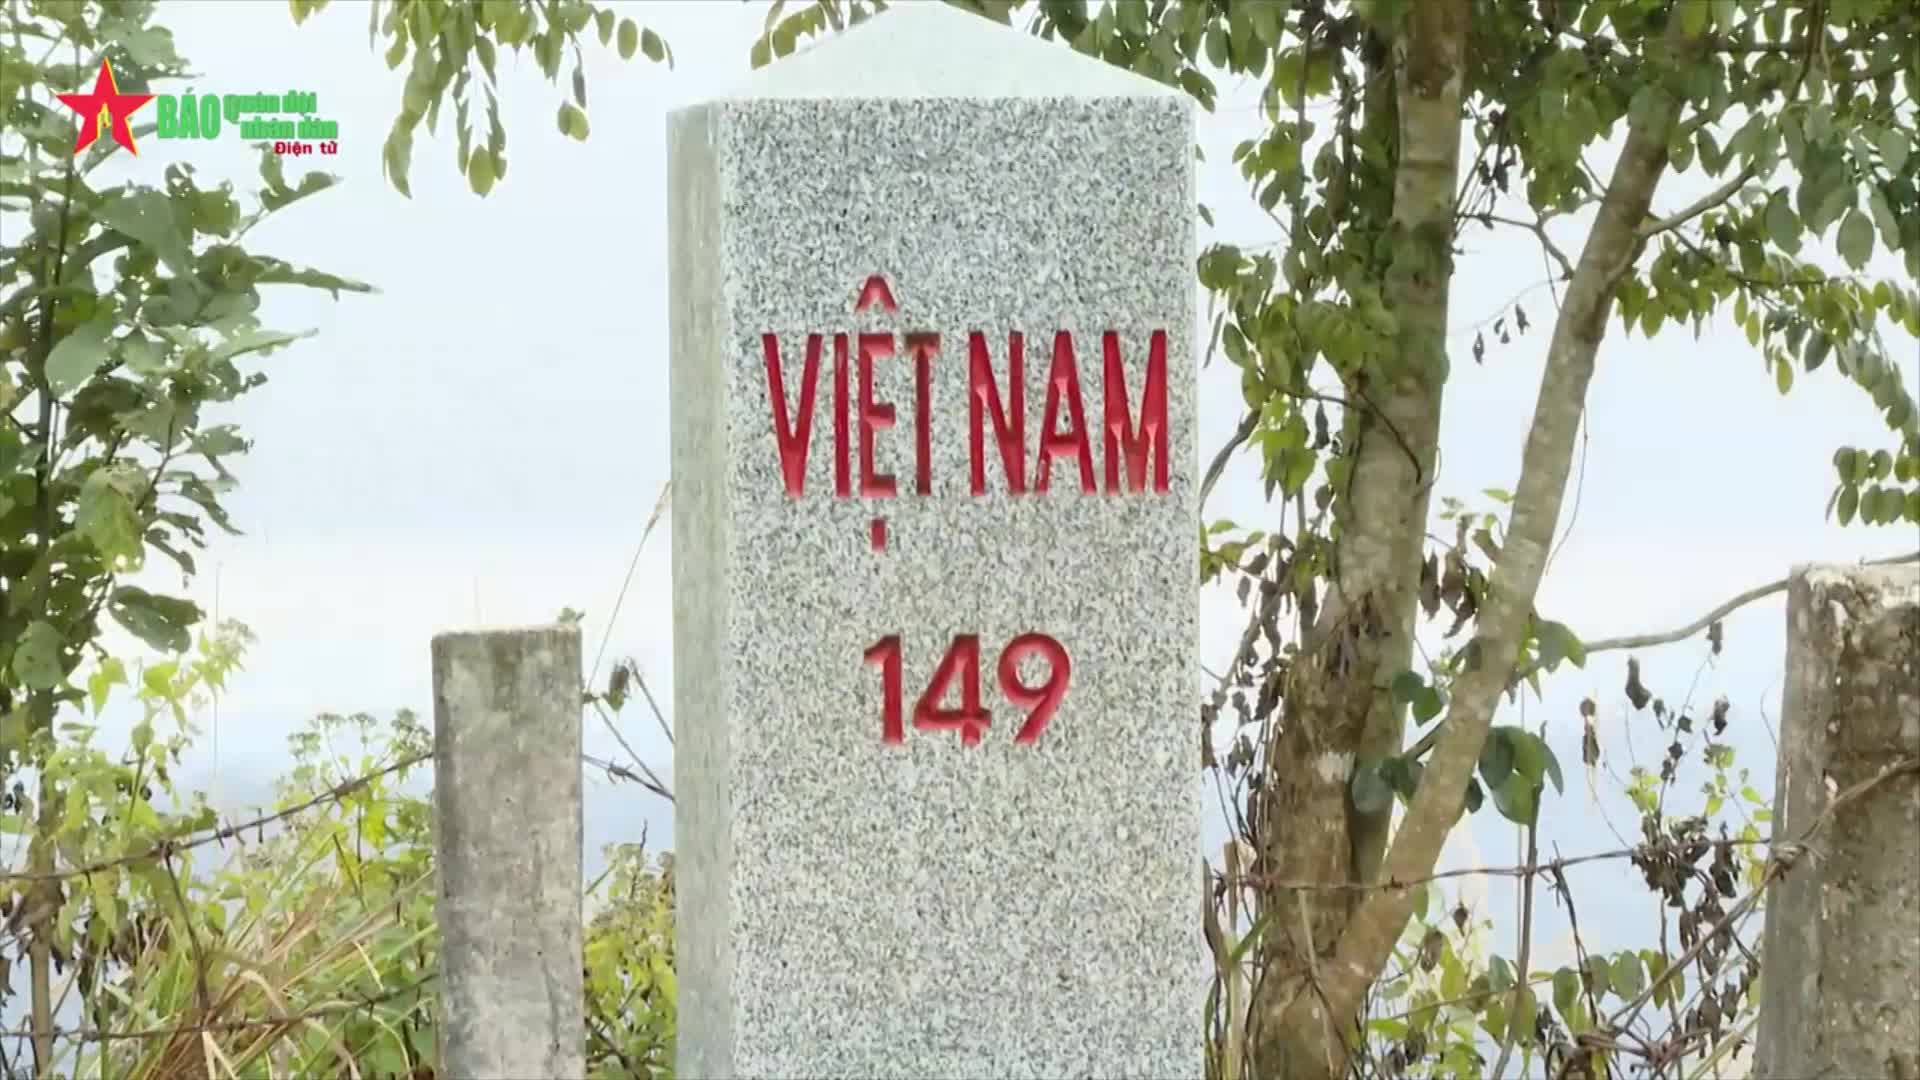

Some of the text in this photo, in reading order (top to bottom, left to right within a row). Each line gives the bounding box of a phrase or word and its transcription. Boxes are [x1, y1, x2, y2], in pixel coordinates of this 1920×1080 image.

[763, 276, 1170, 552] VIỆT NAM
[864, 633, 1071, 746] 149
